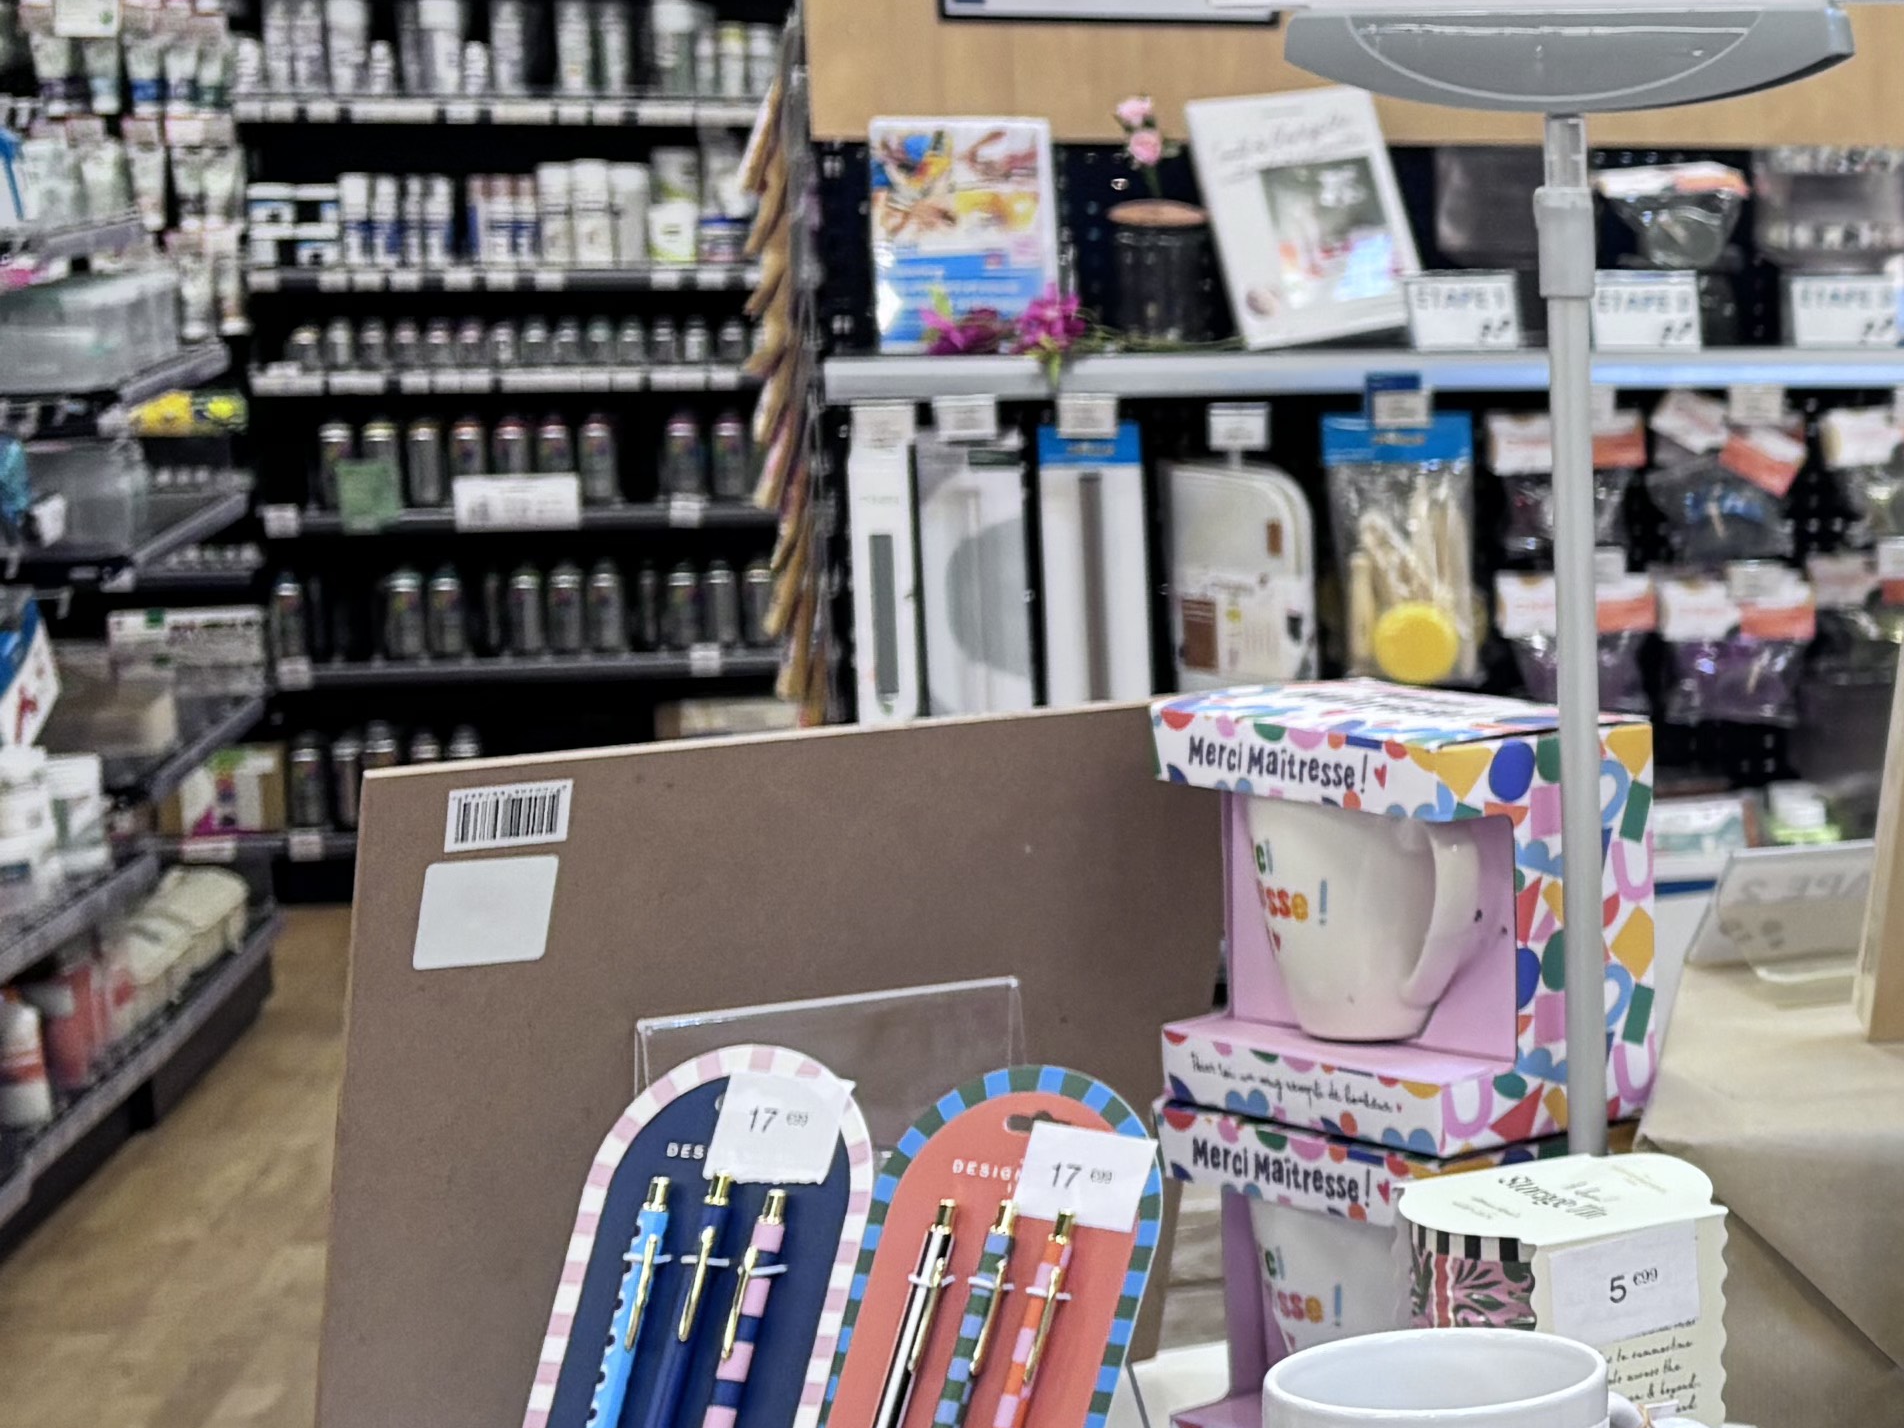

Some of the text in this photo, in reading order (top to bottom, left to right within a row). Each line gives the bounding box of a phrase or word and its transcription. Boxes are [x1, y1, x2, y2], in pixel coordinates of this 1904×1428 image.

[1188, 734, 1243, 772] Merci
[1248, 747, 1356, 789] Maîtresse
[748, 1106, 781, 1135] 17
[1051, 1163, 1083, 1189] 17
[1192, 1135, 1249, 1179] Merci
[1254, 1152, 1360, 1204] Maîtresse
[1609, 1267, 1659, 1304] 5 €99
